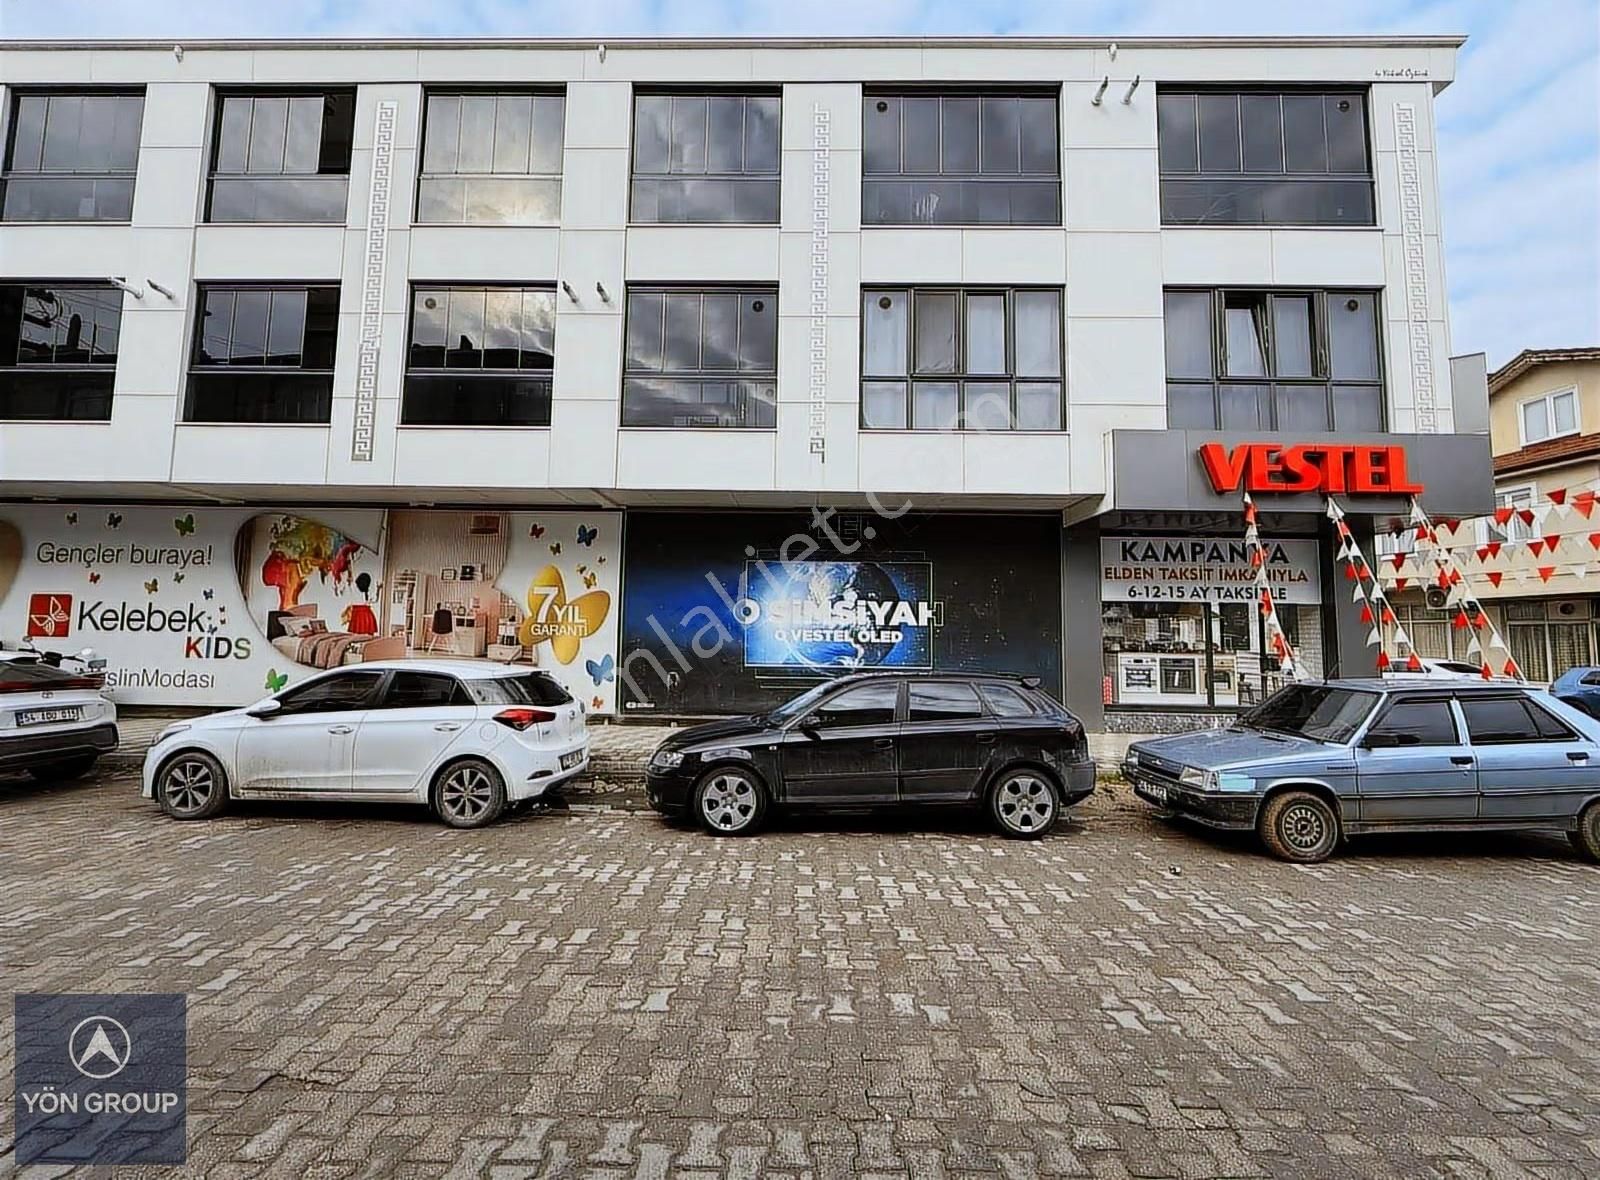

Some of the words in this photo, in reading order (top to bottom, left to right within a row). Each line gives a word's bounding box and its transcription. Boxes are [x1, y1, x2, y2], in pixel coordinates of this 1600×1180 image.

[1198, 443, 1424, 494] VESTEL
[37, 542, 124, 568] Gençler
[130, 543, 212, 569] buraya!
[1104, 567, 1154, 580] ELDEN
[1158, 564, 1213, 580] TAKSİT
[533, 586, 559, 623] 7
[552, 604, 587, 623] YIL
[1128, 586, 1185, 599] 6-12-15
[1190, 587, 1210, 599] AY
[77, 601, 207, 633] Kelebek
[185, 636, 251, 660] KIDS
[791, 630, 851, 643] VESTEL
[858, 631, 903, 643] OLED
[106, 668, 215, 688] slinModası
